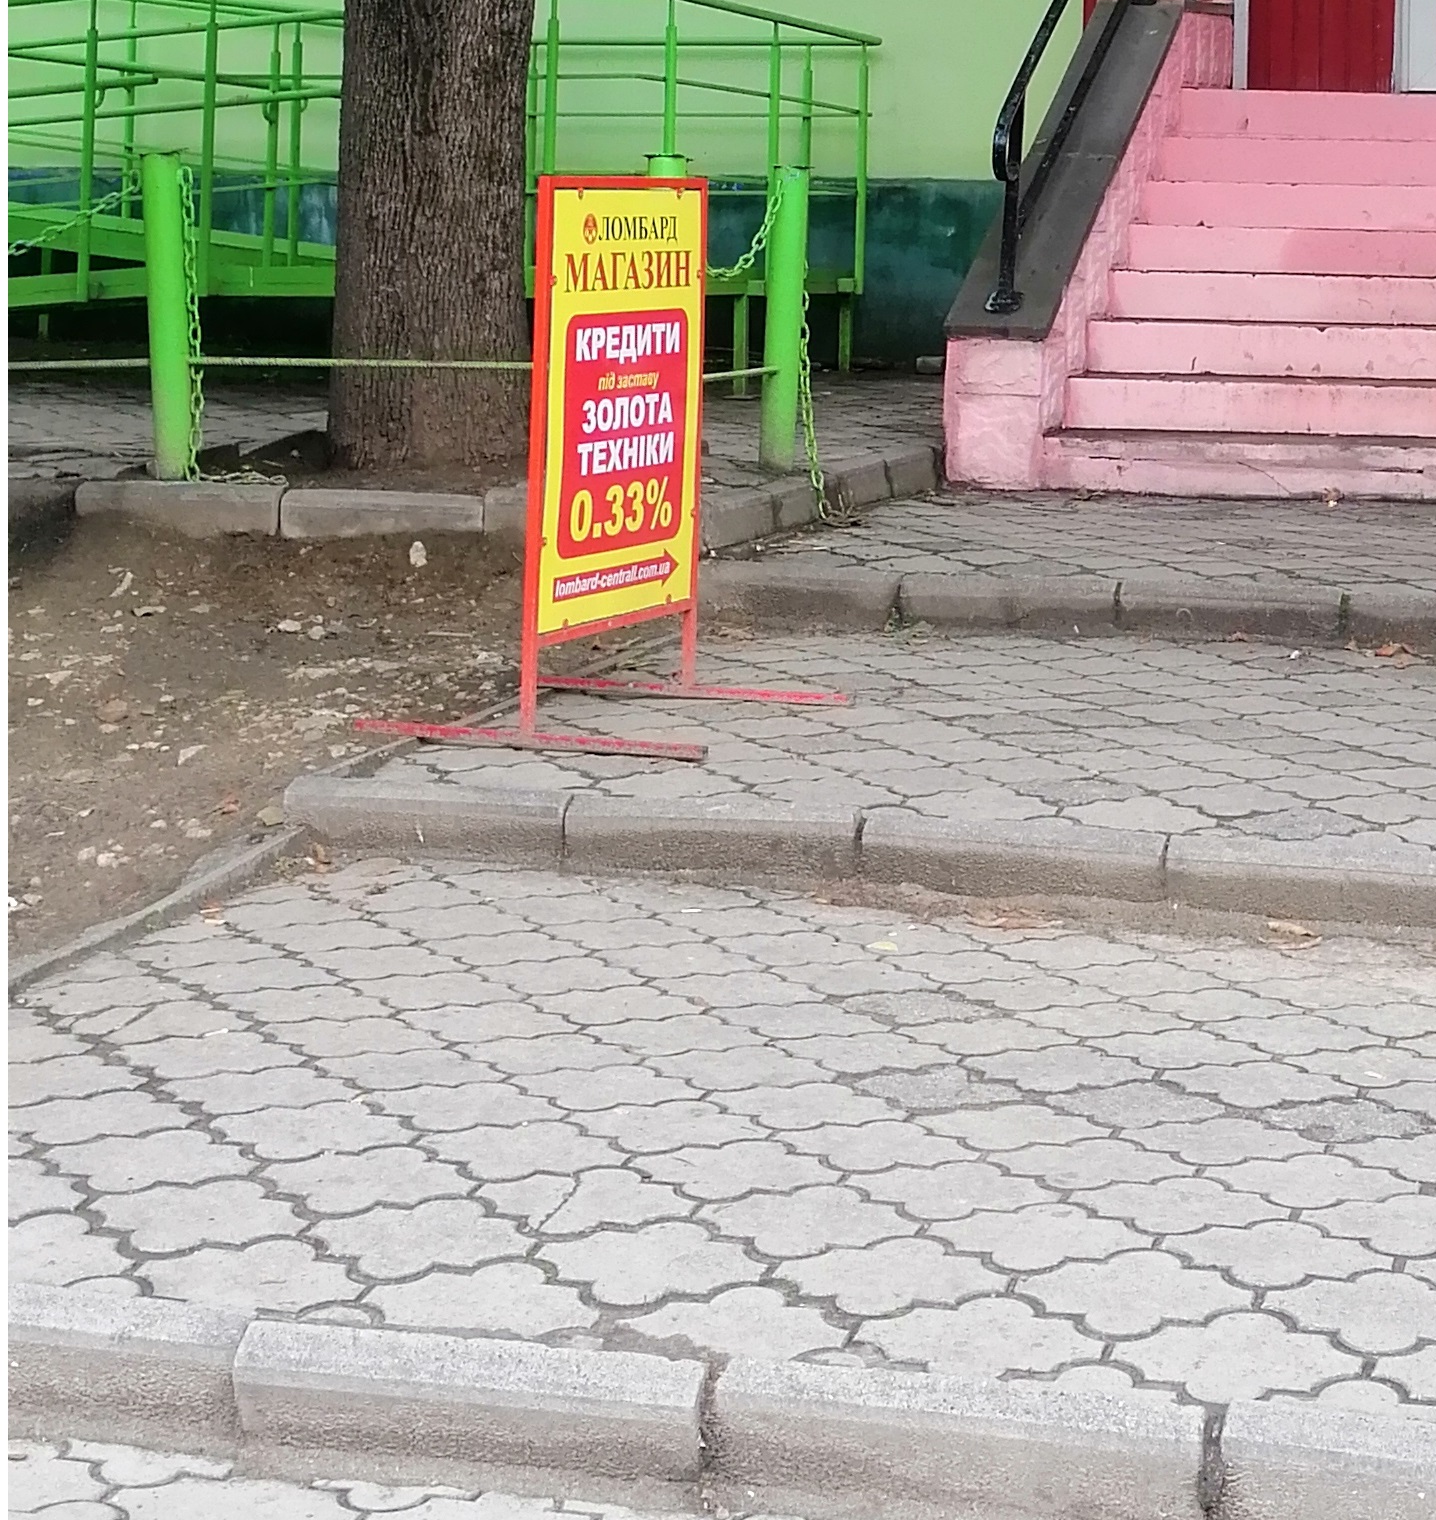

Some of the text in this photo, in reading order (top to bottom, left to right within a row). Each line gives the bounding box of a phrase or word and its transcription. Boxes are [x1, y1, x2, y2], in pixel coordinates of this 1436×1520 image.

[599, 216, 678, 245] ЛОМБАРД
[564, 250, 692, 293] МАГАЗИН
[576, 321, 680, 364] КРЕДИТИ
[597, 371, 659, 391] під заставу
[581, 392, 673, 434] ЗОЛОТА
[577, 431, 675, 476] ТЕХНІКИ
[570, 476, 673, 542] 0.33%
